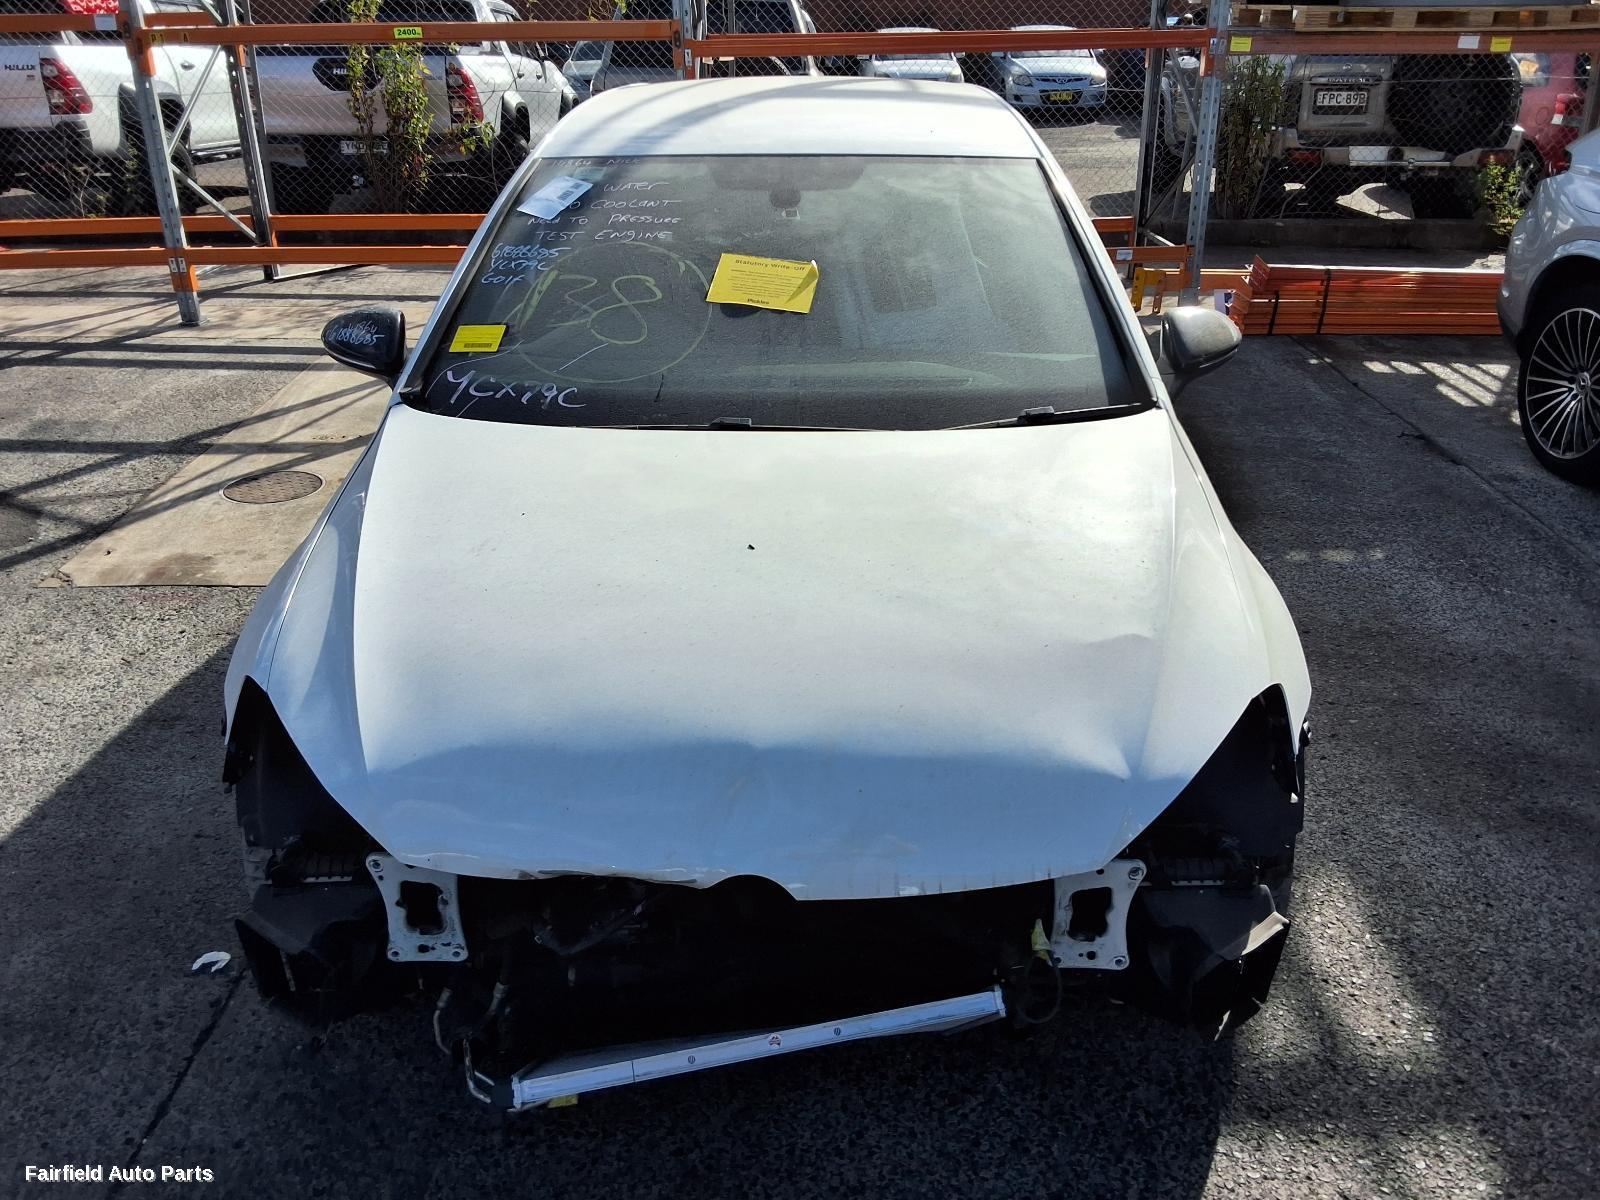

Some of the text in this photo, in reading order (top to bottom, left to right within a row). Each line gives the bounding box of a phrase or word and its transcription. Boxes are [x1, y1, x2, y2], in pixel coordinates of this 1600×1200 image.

[397, 28, 417, 36] 2400
[570, 216, 590, 225] TO
[536, 231, 585, 241] TEST
[446, 369, 588, 410] YCX79C
